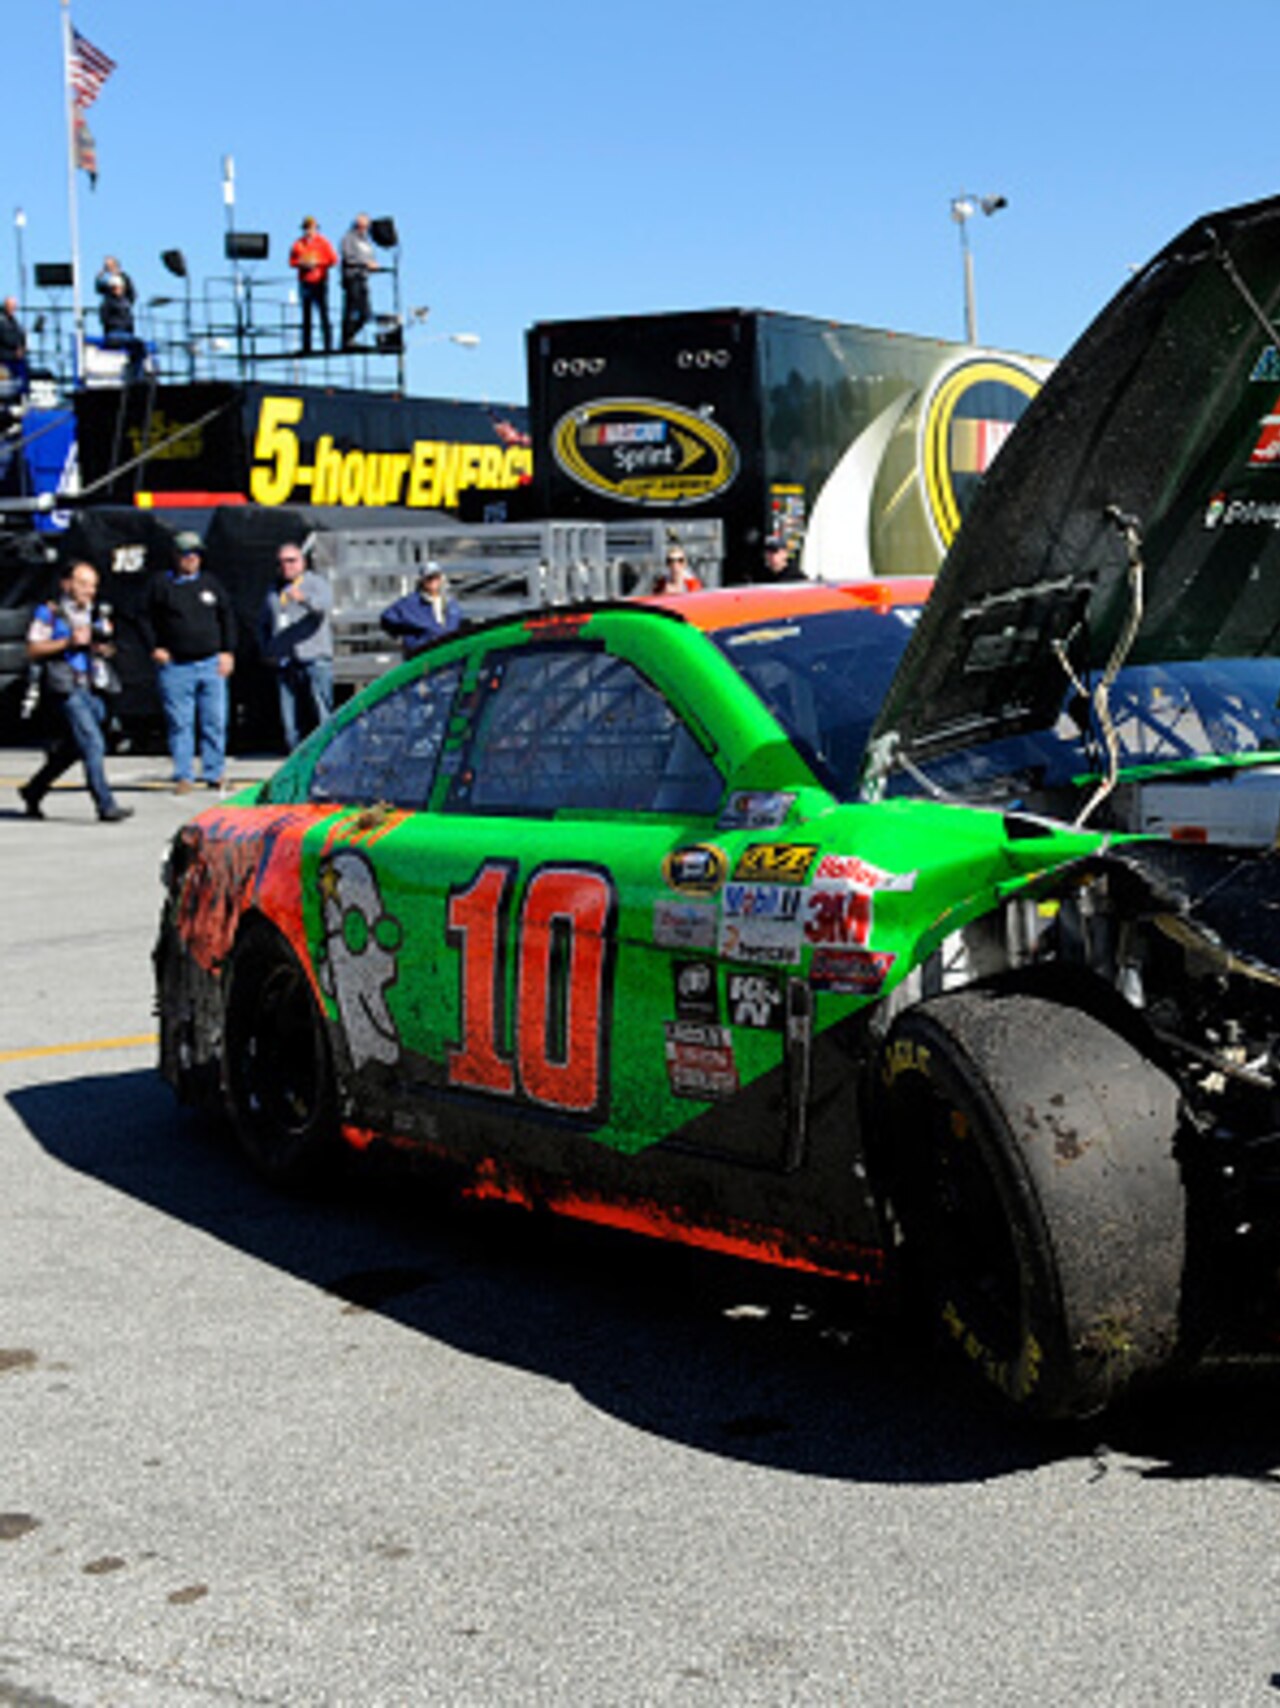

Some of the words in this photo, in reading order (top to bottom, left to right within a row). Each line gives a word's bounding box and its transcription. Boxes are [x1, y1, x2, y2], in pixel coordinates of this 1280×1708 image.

[250, 395, 411, 506] 5-hour
[406, 439, 532, 507] ENERG
[612, 444, 674, 473] Sprint
[804, 891, 870, 944] 3M
[446, 858, 617, 1115] 10
